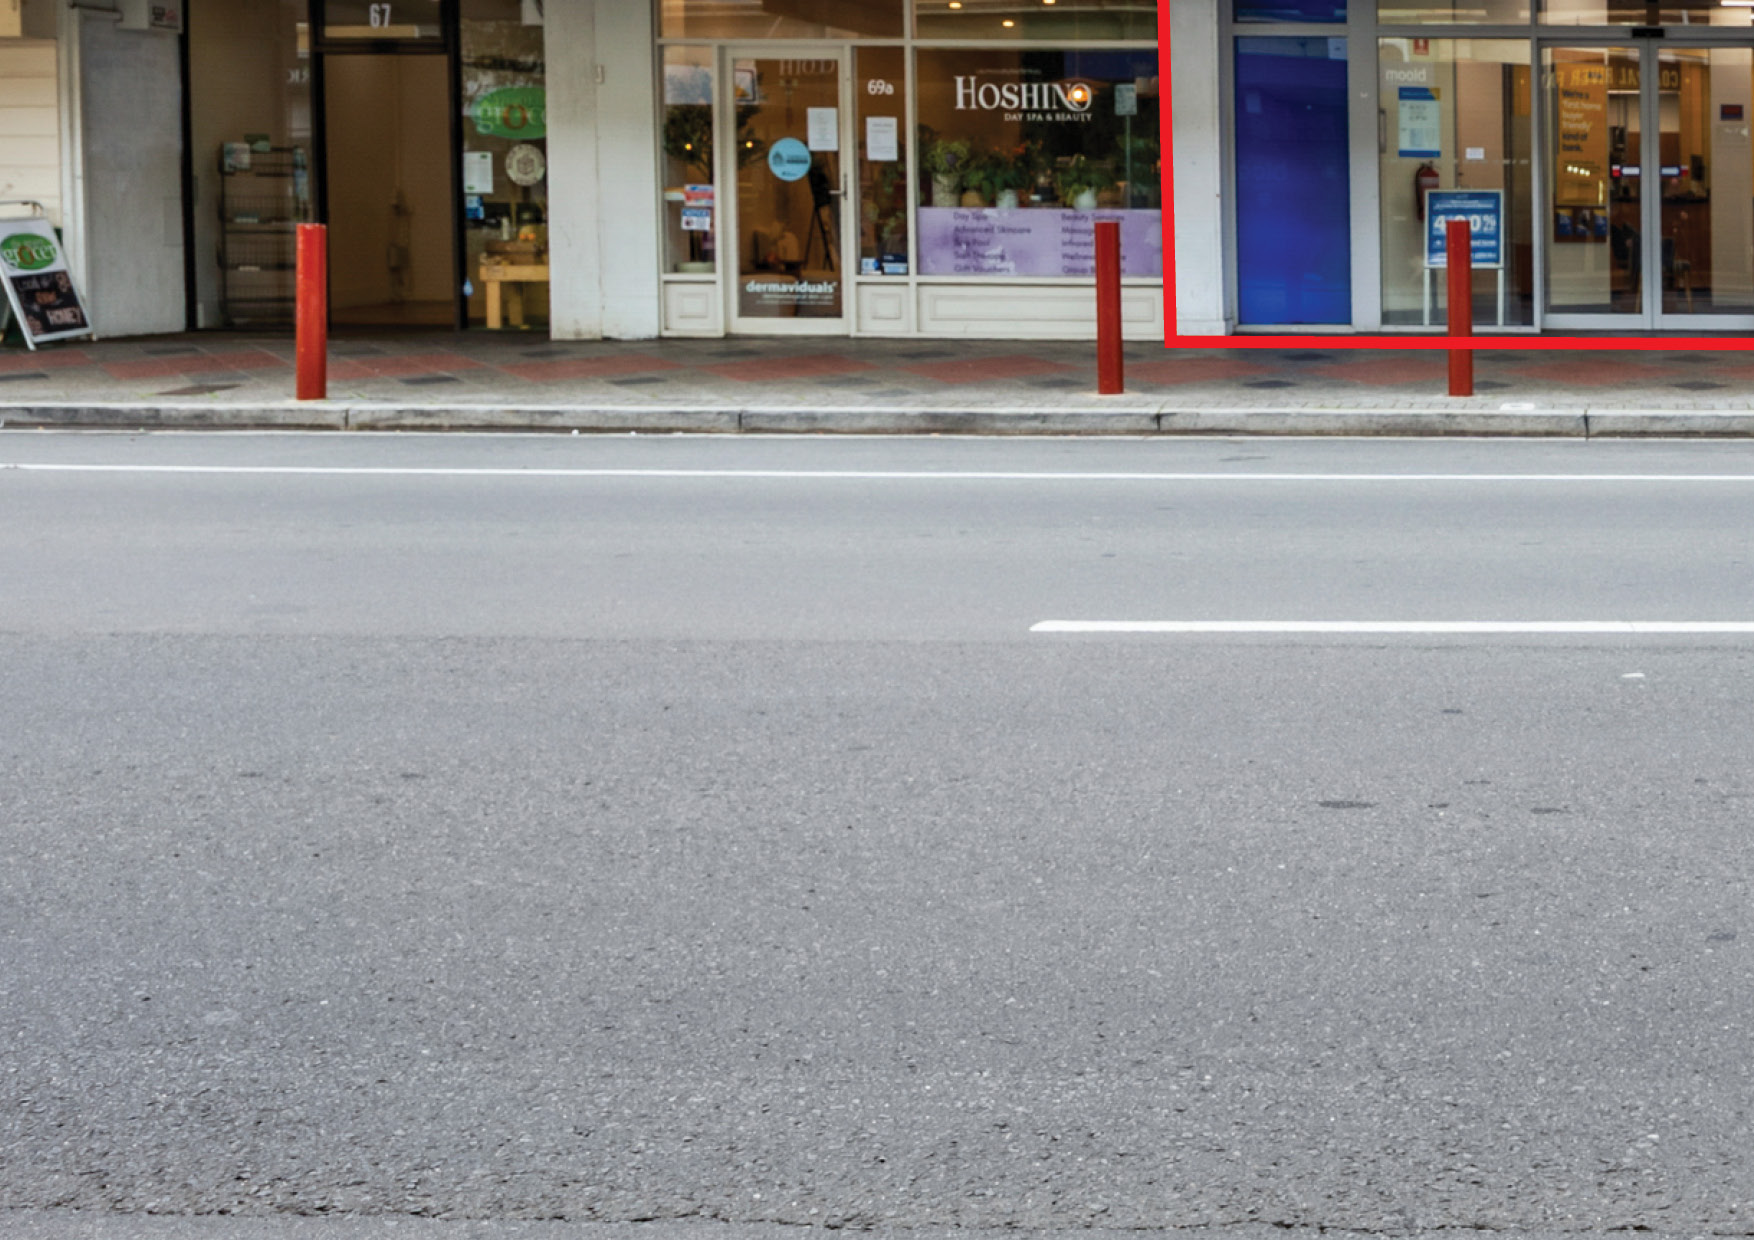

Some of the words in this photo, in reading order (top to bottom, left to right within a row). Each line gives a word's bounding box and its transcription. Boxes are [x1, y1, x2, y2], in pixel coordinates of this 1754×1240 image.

[369, 3, 392, 29] 67
[867, 79, 895, 95] 69a
[954, 75, 1093, 112] HOSHINO
[1003, 113, 1024, 122] DAY
[1026, 113, 1043, 122] SPA
[1055, 113, 1093, 122] BEAUTY
[1061, 213, 1088, 223] Beauty
[953, 226, 994, 234] Advanced
[1061, 226, 1095, 236] Massag
[1061, 252, 1095, 260] Wellnes
